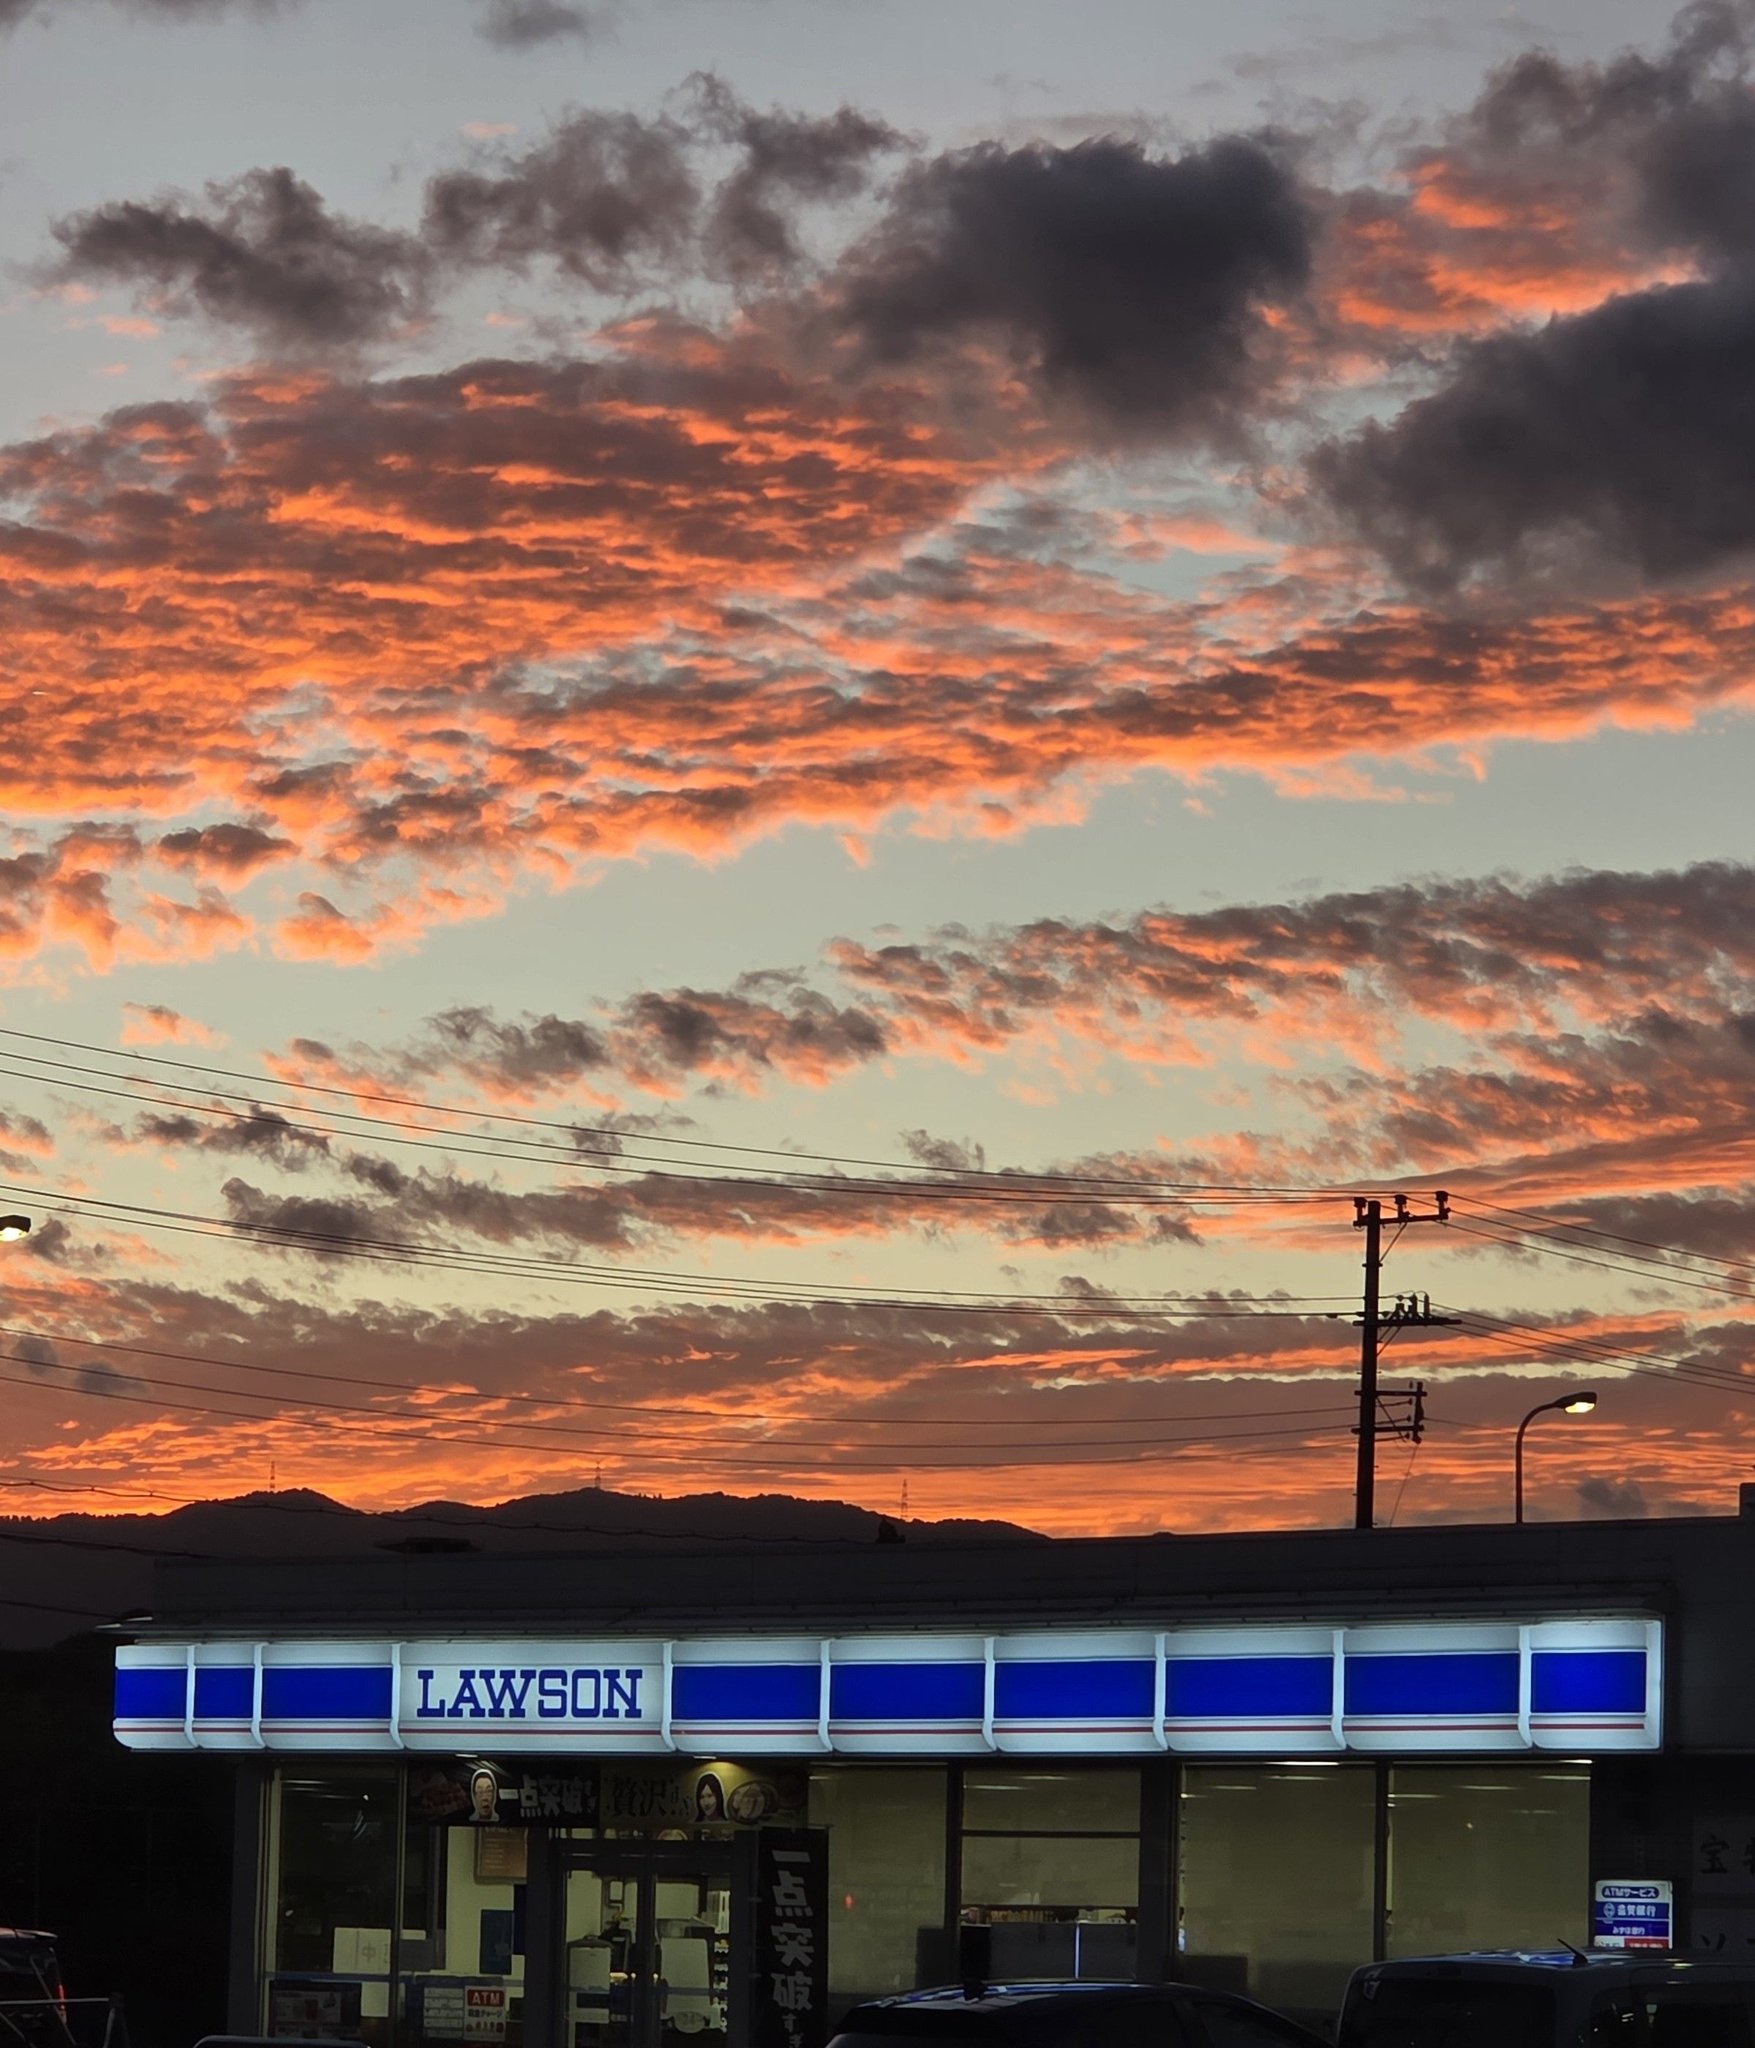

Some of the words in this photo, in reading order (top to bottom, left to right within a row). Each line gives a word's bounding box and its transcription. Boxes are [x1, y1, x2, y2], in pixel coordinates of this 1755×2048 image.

[417, 1669, 643, 1718] LAWSON
[1604, 1887, 1657, 1898] ATMサービス
[471, 1991, 500, 2005] ATM
